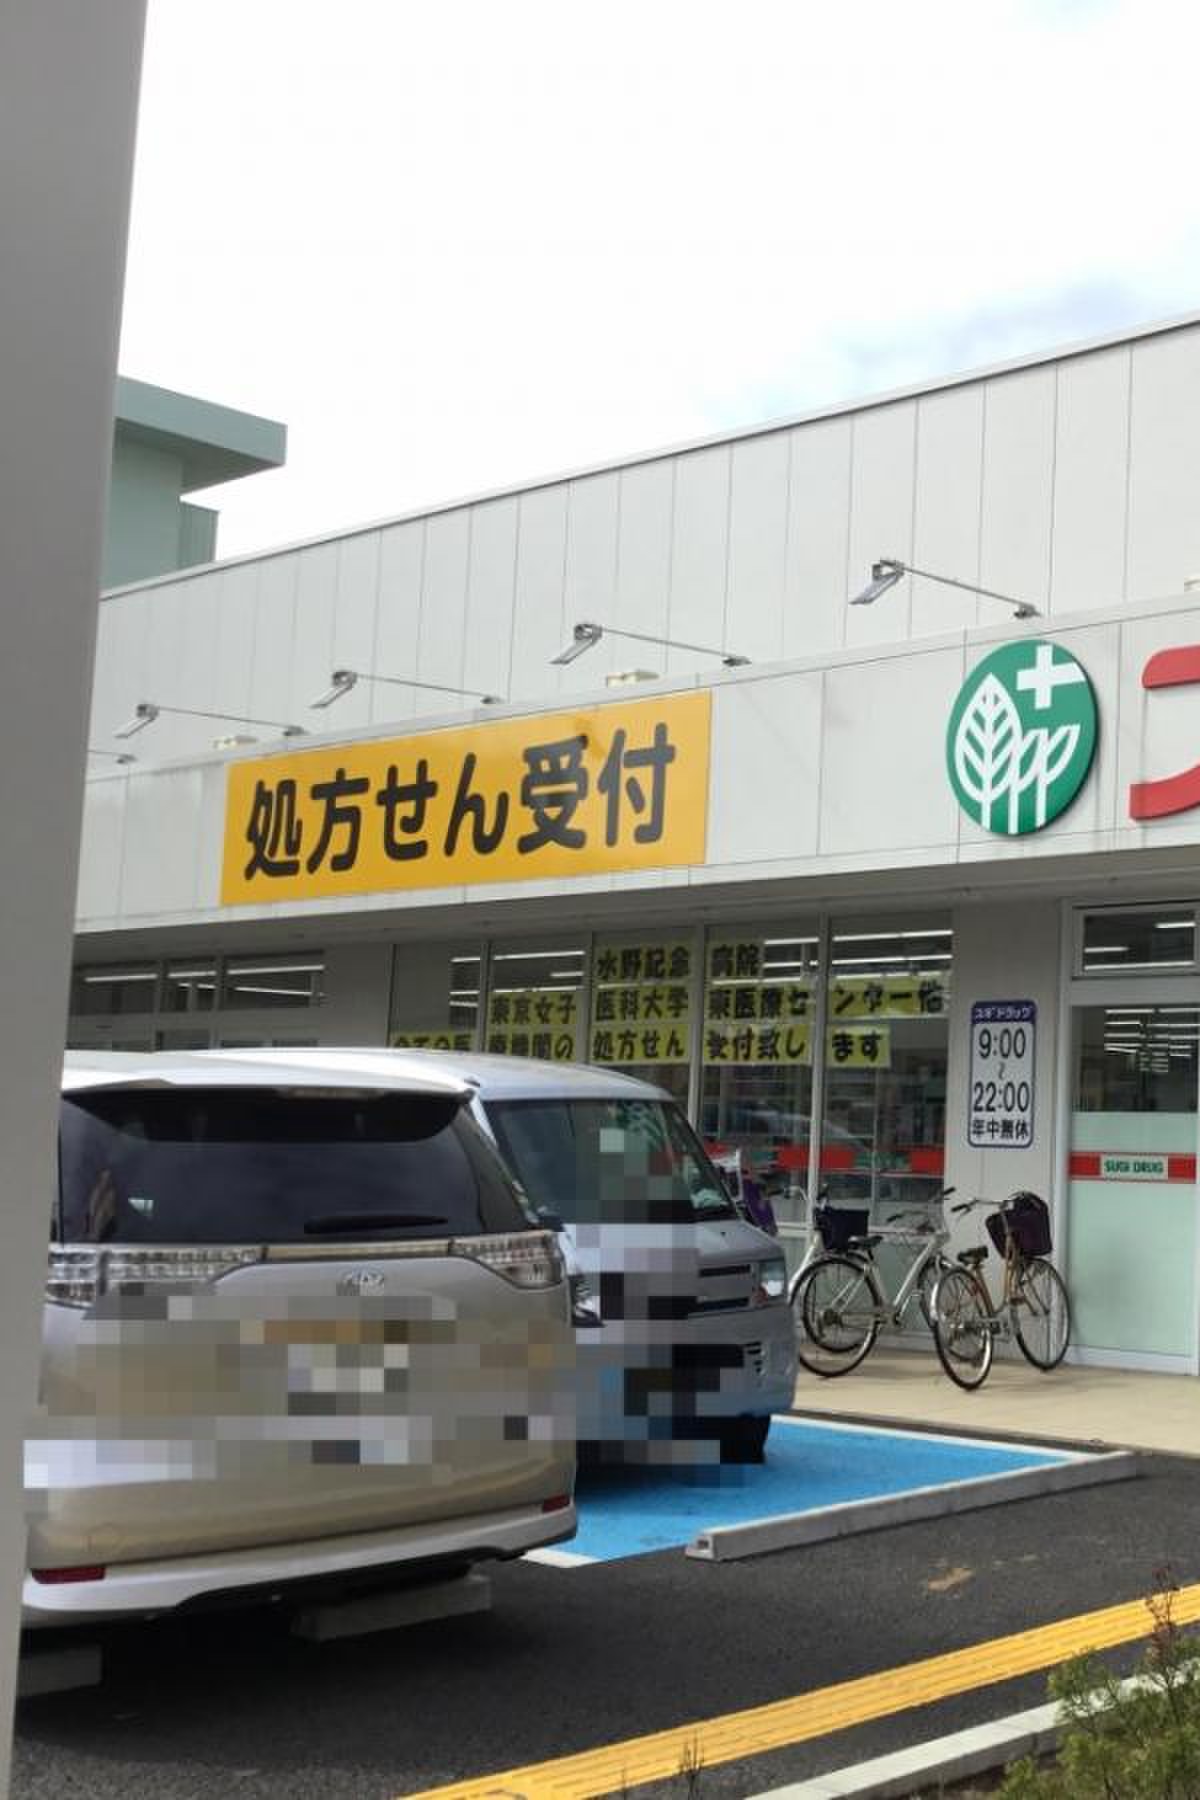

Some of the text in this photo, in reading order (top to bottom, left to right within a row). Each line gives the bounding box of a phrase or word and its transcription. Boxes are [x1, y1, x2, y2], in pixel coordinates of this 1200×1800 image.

[244, 722, 676, 880] 処方せん受付
[979, 1028, 1026, 1059] 9:00
[973, 1081, 1030, 1112] 22:00
[972, 1117, 1029, 1139] 年中無休
